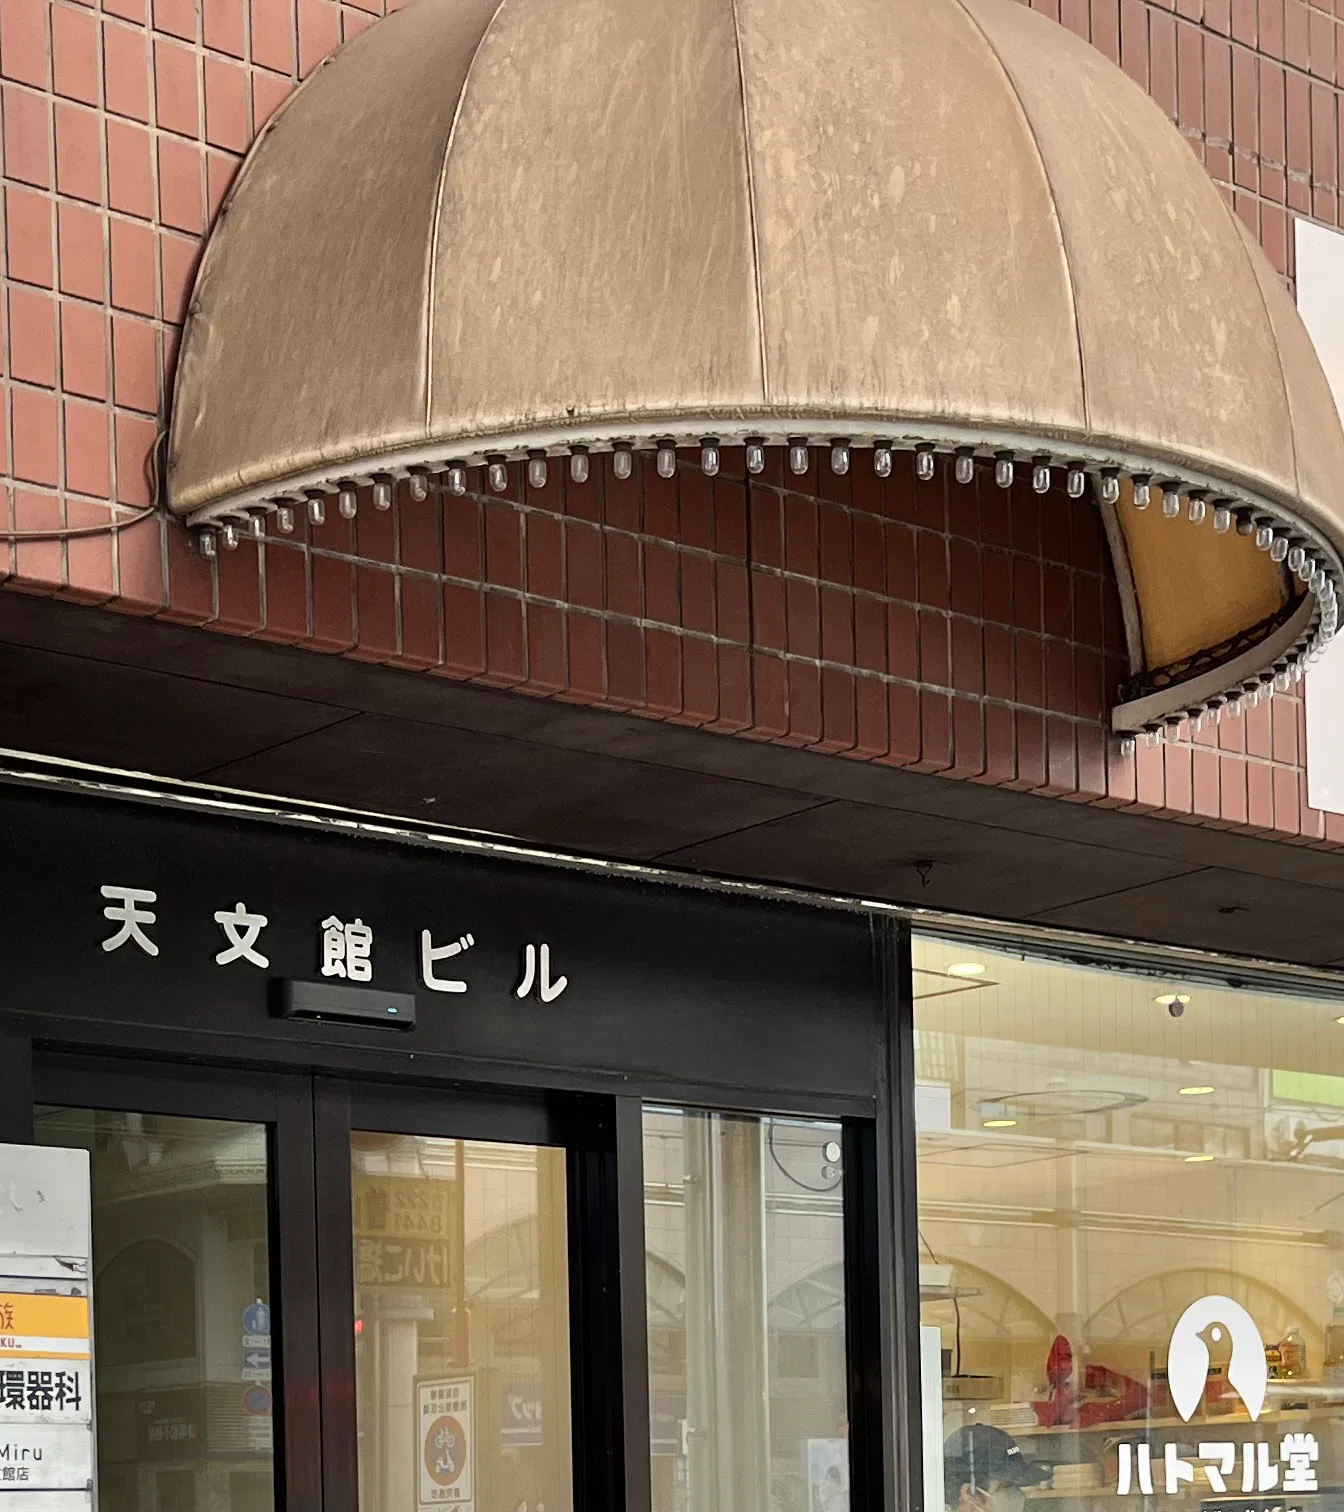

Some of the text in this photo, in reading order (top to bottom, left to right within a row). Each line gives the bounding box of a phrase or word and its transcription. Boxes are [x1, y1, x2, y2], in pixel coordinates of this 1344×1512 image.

[101, 885, 567, 1002] 天文館ビル
[1117, 1433, 1318, 1495] ハトマル堂
